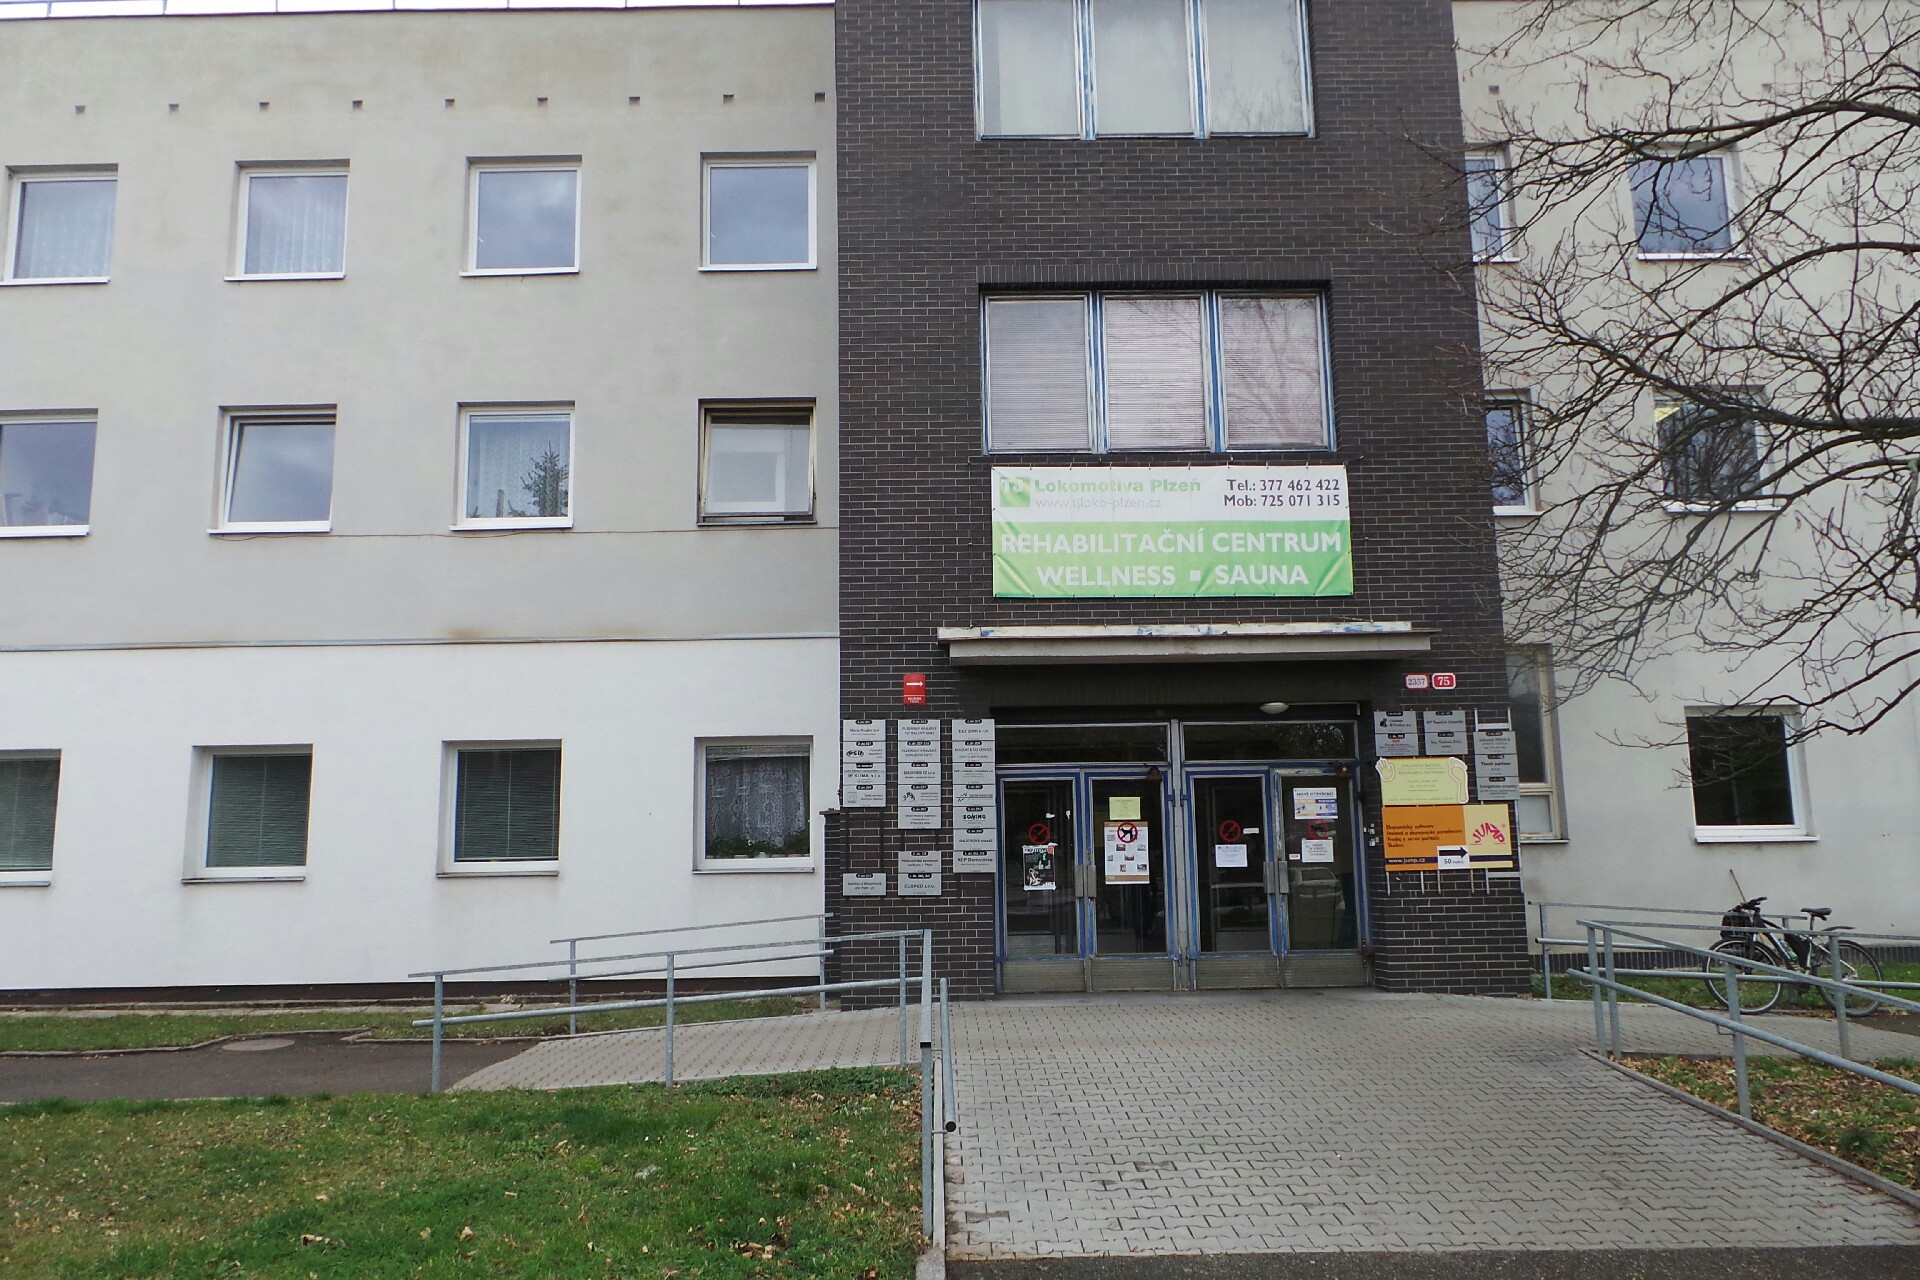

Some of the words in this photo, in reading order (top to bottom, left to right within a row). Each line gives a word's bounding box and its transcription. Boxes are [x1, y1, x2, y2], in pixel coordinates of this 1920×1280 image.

[1034, 478, 1144, 493] Lokomotiva
[1150, 477, 1201, 493] Plzeň
[1226, 479, 1256, 492] Tel.:
[1260, 479, 1283, 491] 377
[1287, 479, 1312, 491] 462
[1315, 479, 1340, 491] 422
[1035, 496, 1162, 510] www.tjloko-plzen.cz
[1223, 494, 1257, 507] Mob:
[1261, 495, 1286, 507] 725
[1288, 495, 1311, 507] 071
[1317, 494, 1340, 507] 315
[1001, 528, 1204, 554] REHABILITAČNÍ
[1212, 531, 1342, 553] CENTRUM
[1036, 565, 1176, 586] WELLNESS
[1215, 564, 1310, 586] SAUNA
[1407, 678, 1425, 686] 2357
[1437, 676, 1451, 686] 75
[1472, 822, 1505, 844] JUMP
